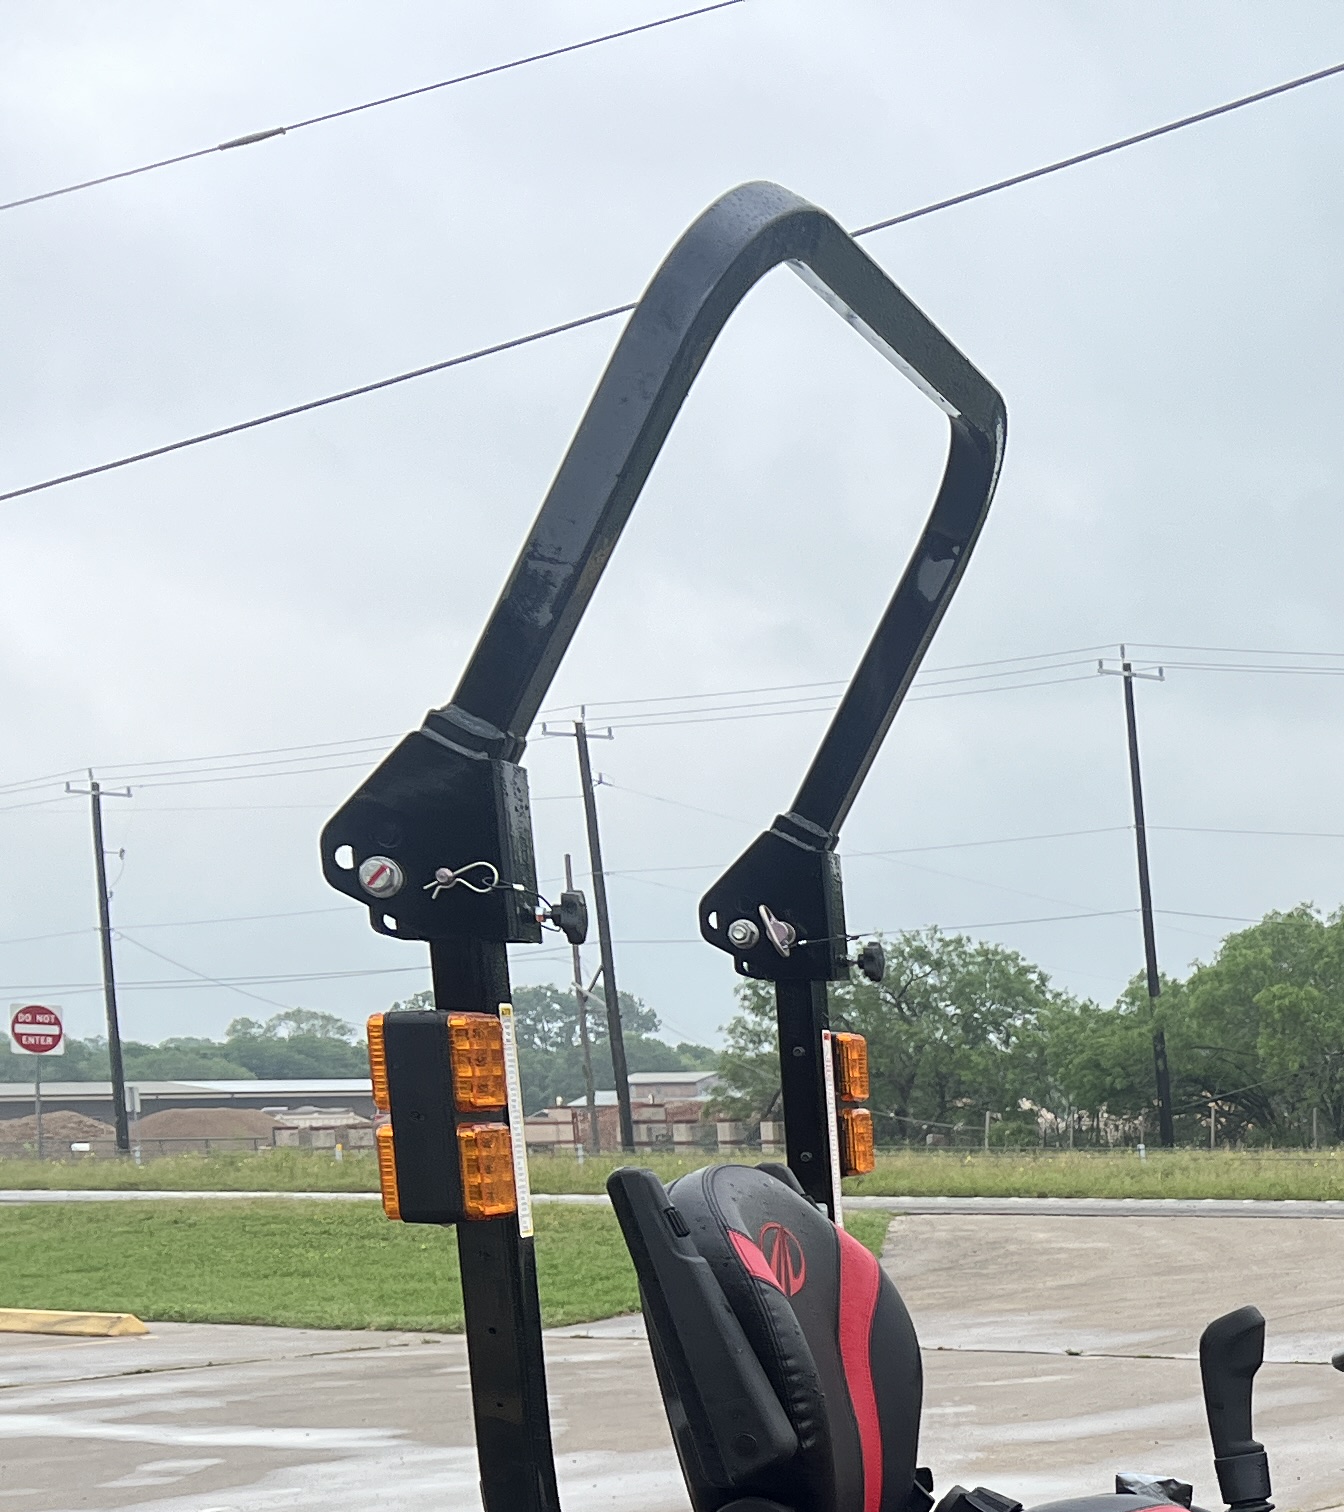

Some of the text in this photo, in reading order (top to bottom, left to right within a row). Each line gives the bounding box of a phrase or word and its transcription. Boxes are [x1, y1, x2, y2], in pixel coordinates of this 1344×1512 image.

[18, 1012, 55, 1023] DO NOT
[22, 1035, 53, 1045] ENTER
